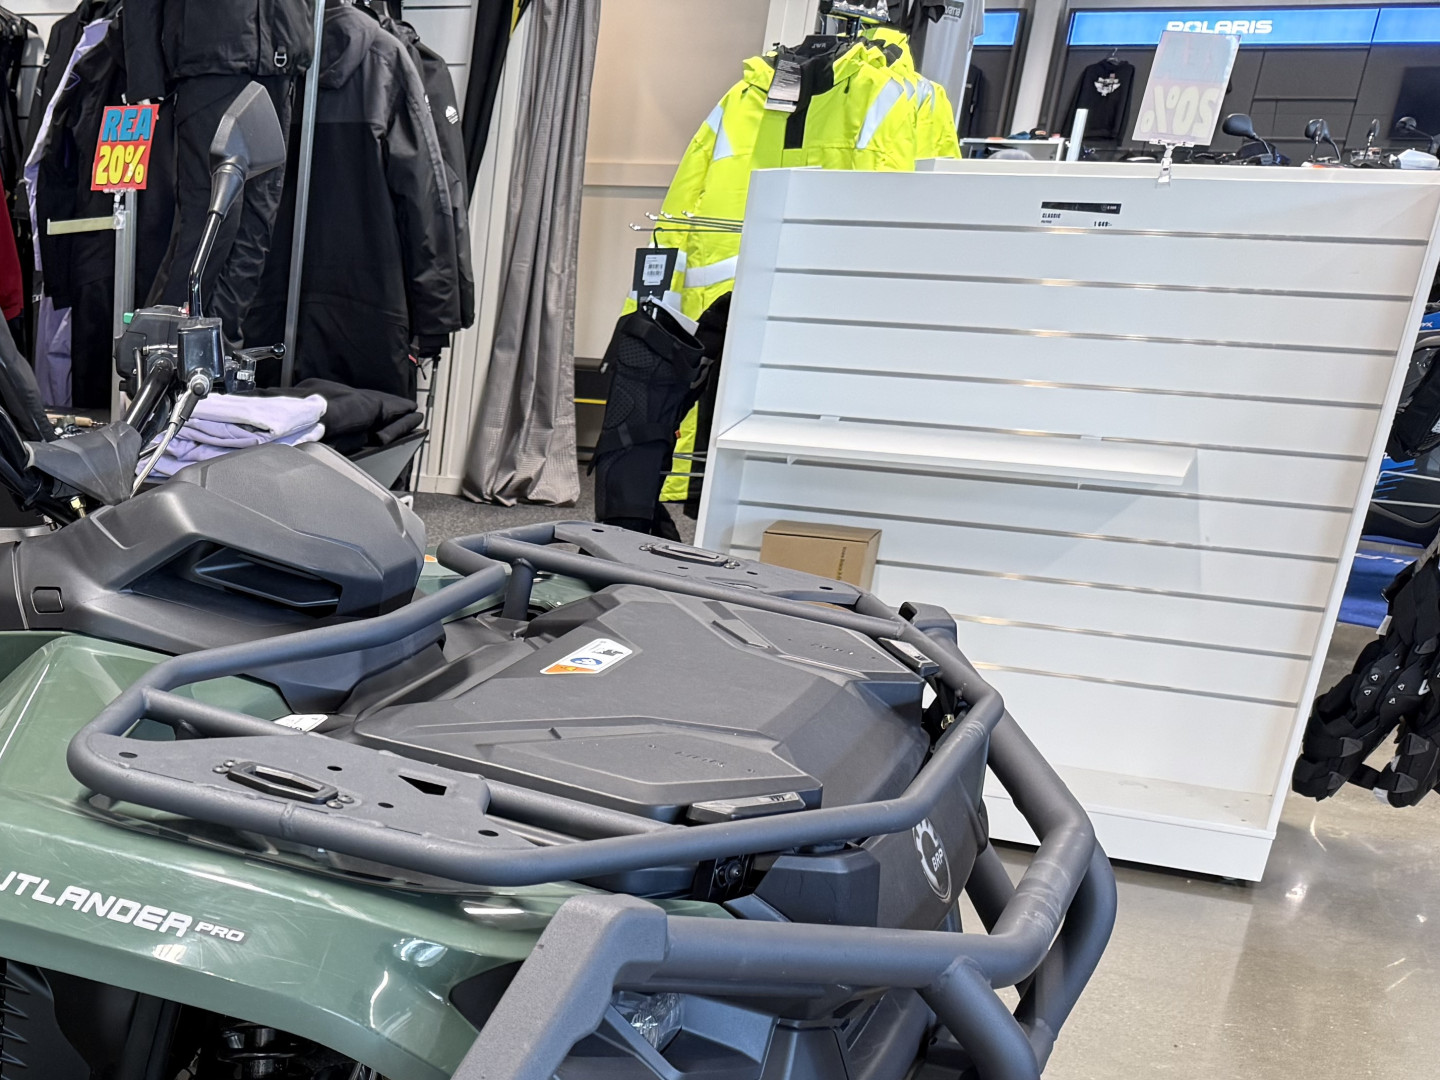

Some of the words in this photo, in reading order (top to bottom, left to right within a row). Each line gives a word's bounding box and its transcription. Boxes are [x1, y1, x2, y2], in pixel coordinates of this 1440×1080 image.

[1166, 20, 1272, 34] POLARIS
[101, 108, 152, 142] REA
[95, 144, 146, 185] 20%
[931, 847, 943, 872] BRP
[195, 921, 246, 943] PRO
